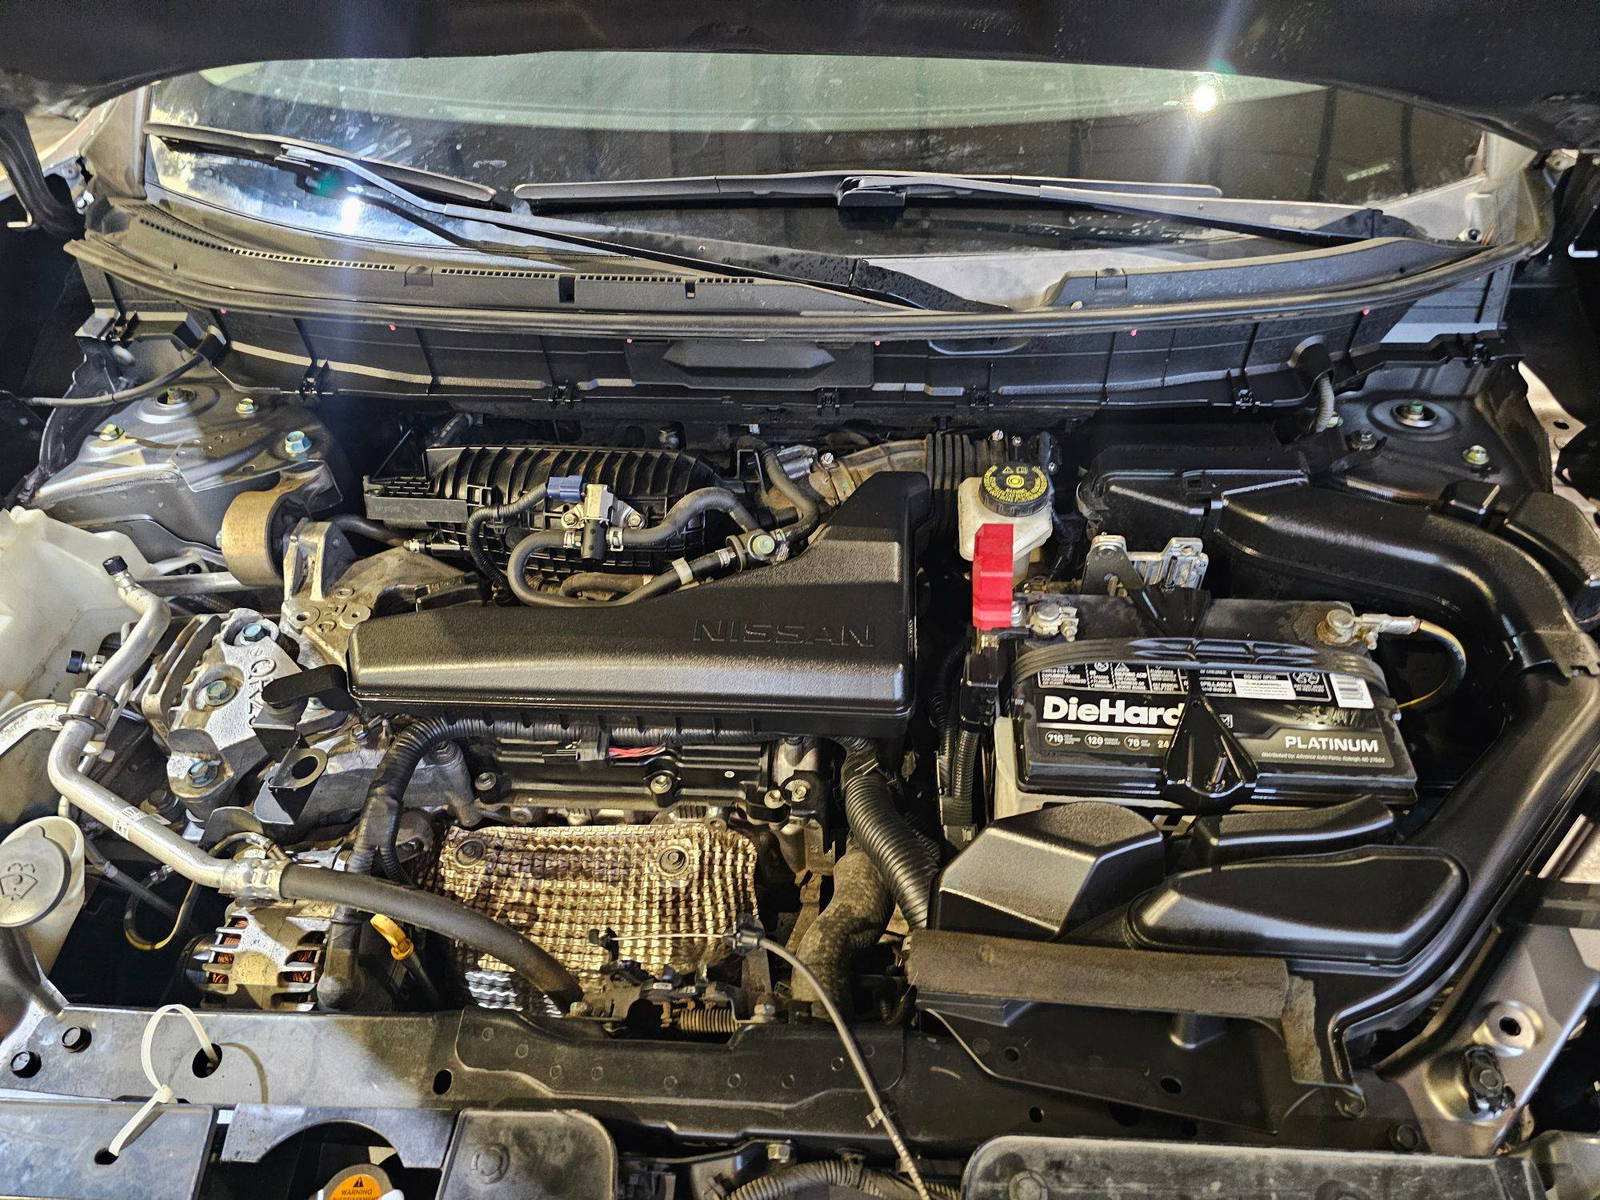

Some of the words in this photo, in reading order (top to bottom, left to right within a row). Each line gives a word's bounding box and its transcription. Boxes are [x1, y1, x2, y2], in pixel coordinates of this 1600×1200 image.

[693, 619, 875, 648] NISSAN
[1047, 734, 1064, 743] 710
[1284, 735, 1379, 753] PLATINUM
